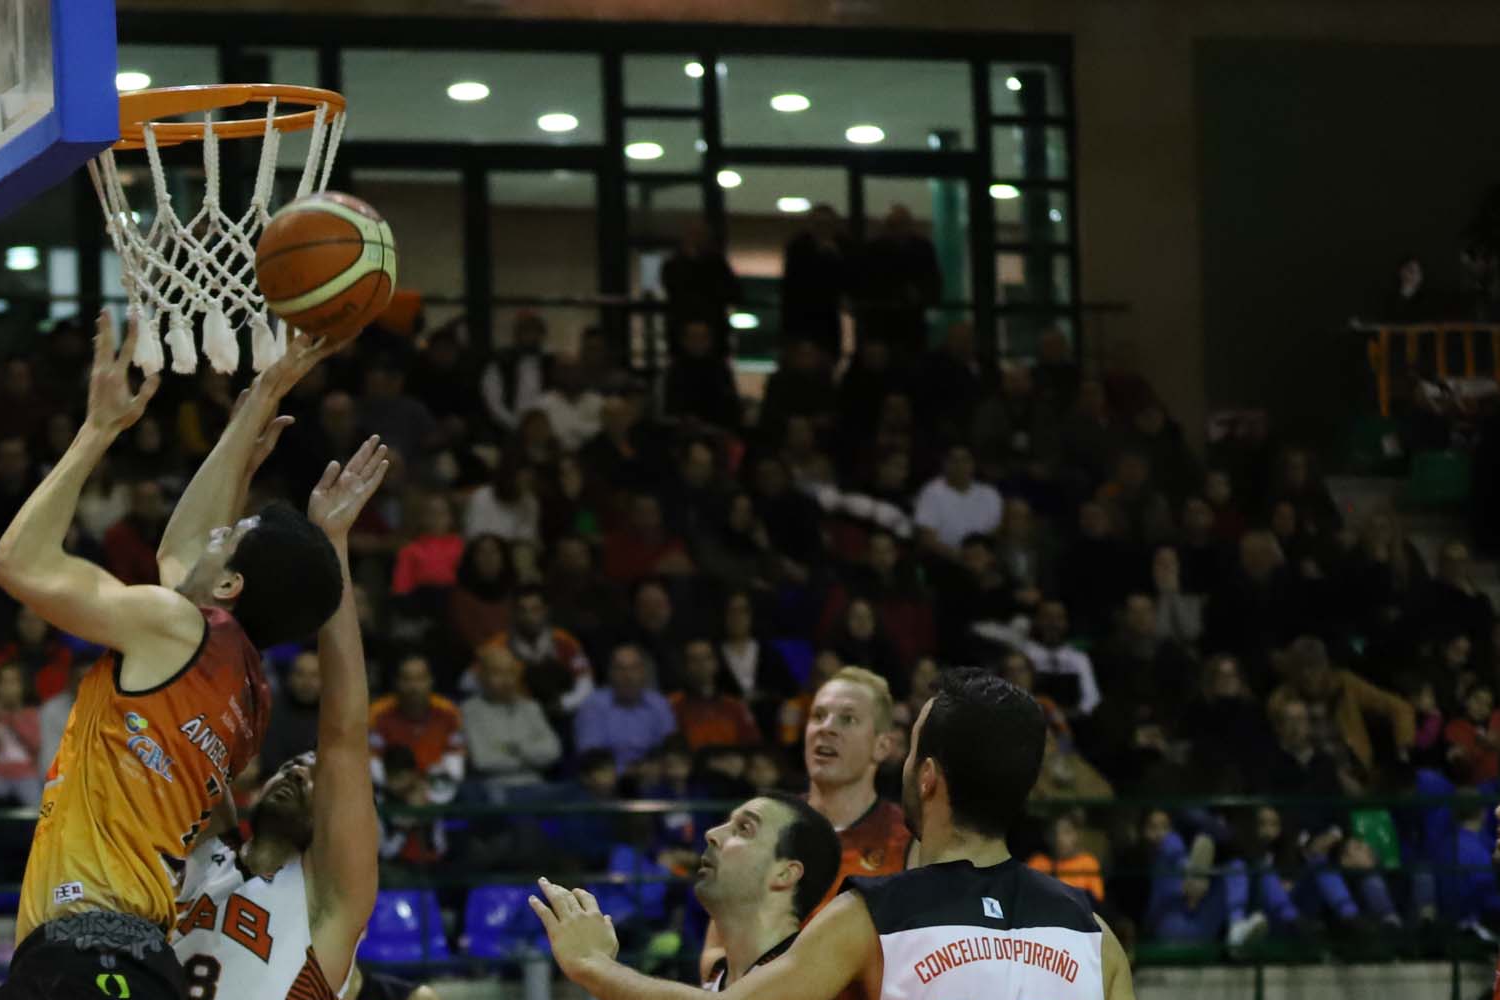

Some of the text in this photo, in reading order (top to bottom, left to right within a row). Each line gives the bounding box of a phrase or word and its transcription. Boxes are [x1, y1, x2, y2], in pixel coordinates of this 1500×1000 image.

[913, 936, 1080, 985] CONCELLO DO PORRIÑO
